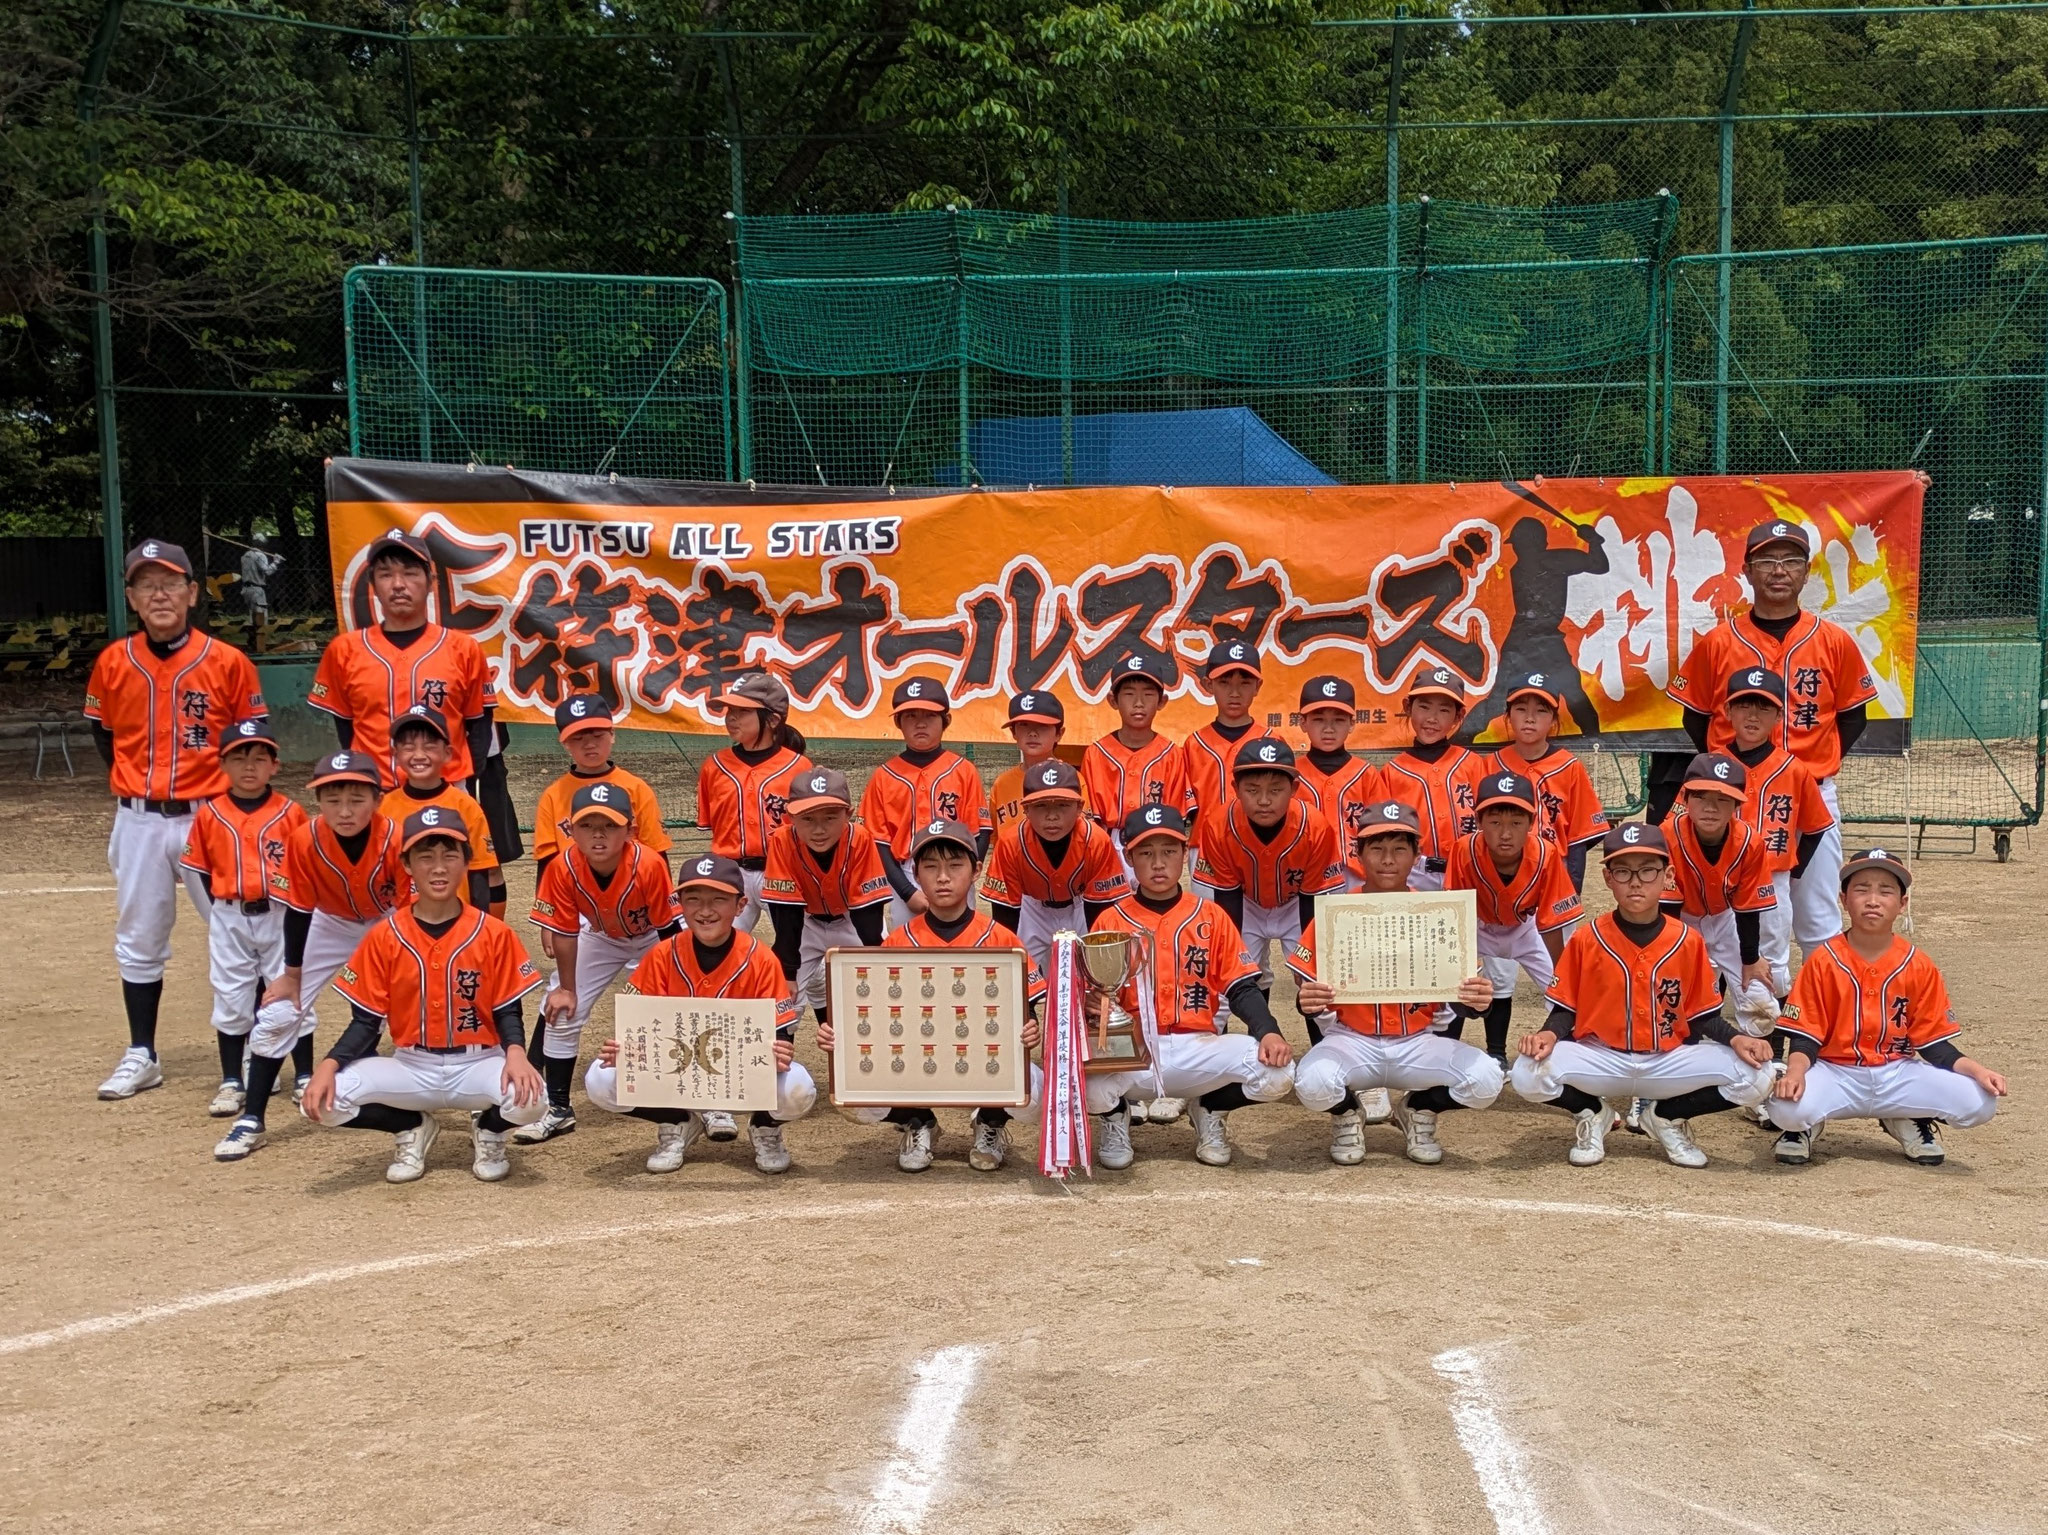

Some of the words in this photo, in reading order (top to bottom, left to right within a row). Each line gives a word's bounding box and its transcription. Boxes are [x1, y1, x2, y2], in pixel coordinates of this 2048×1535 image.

[521, 520, 652, 557] FUTSU
[671, 522, 750, 558] ALL
[769, 517, 901, 555] STARS
[506, 517, 1499, 729] 符津オールスターズ
[182, 691, 210, 751] 符津
[421, 679, 448, 709] 符
[1792, 667, 1822, 730] 符津
[1764, 793, 1793, 857] 符津
[1197, 921, 1211, 940] C
[1182, 944, 1210, 1014] 符津
